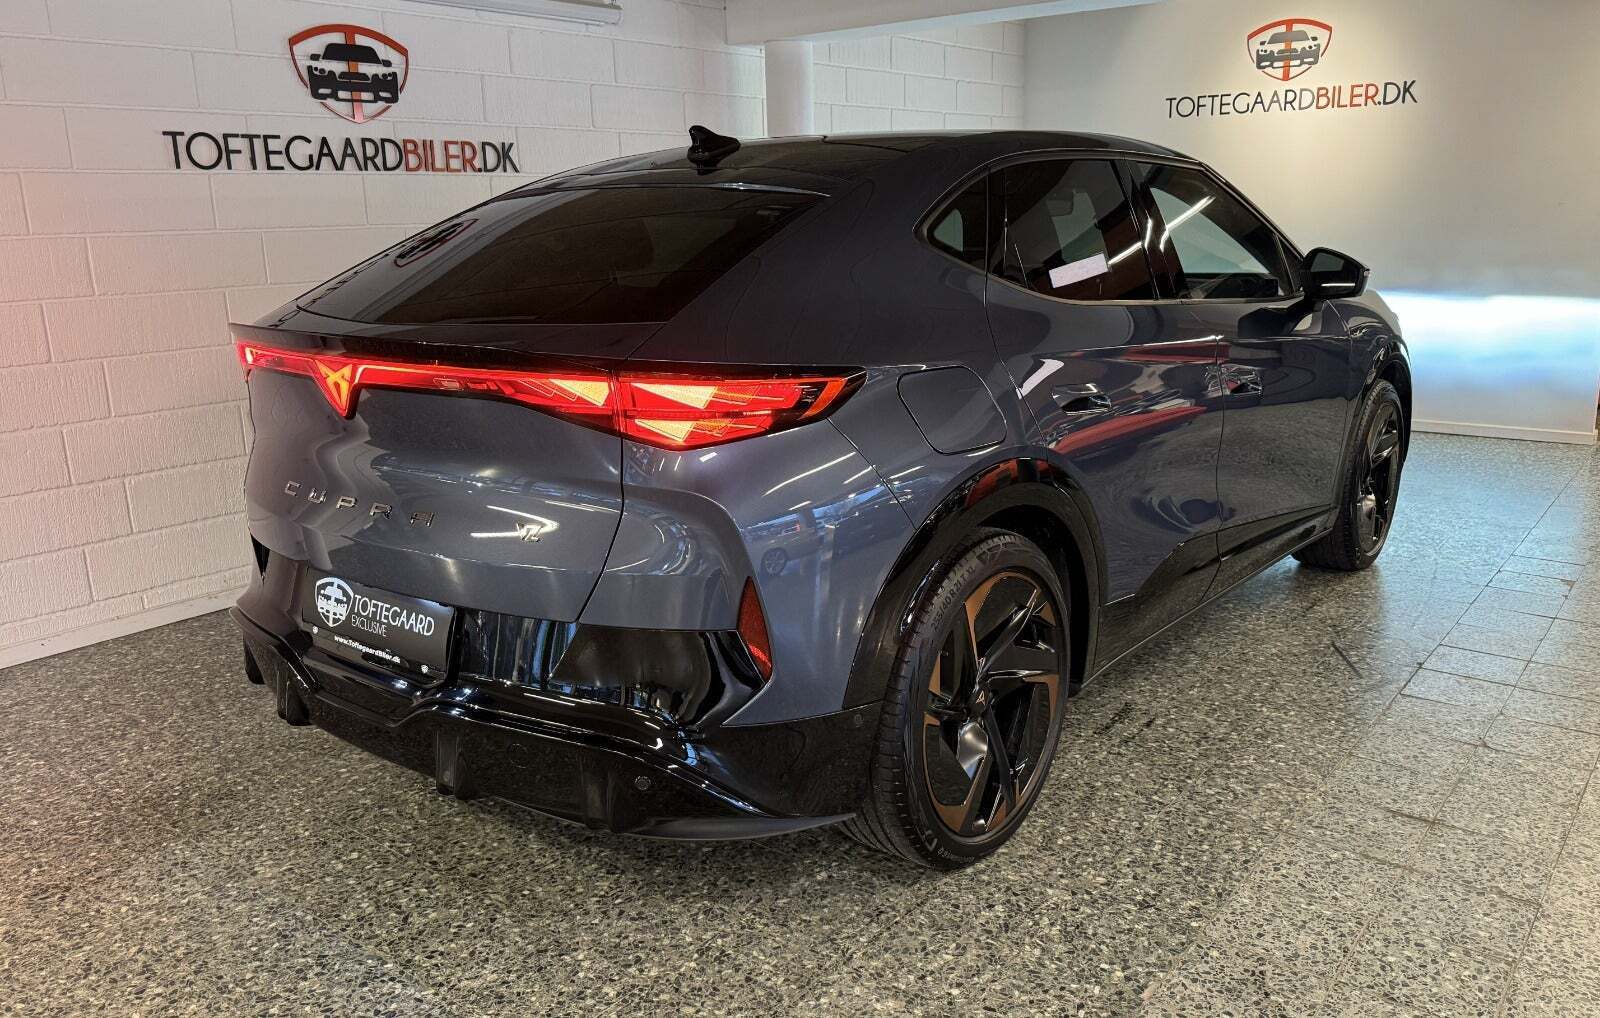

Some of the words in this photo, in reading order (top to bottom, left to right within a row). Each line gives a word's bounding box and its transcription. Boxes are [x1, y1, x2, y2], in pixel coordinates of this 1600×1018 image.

[1165, 79, 1418, 119] TOFTEGAARDBILER.DK
[162, 130, 520, 174] TOFTEGAARDBILER.DK
[284, 480, 435, 527] CUPRA
[351, 614, 387, 637] EXCLUSIVE
[353, 594, 435, 636] TOFTEGAARD
